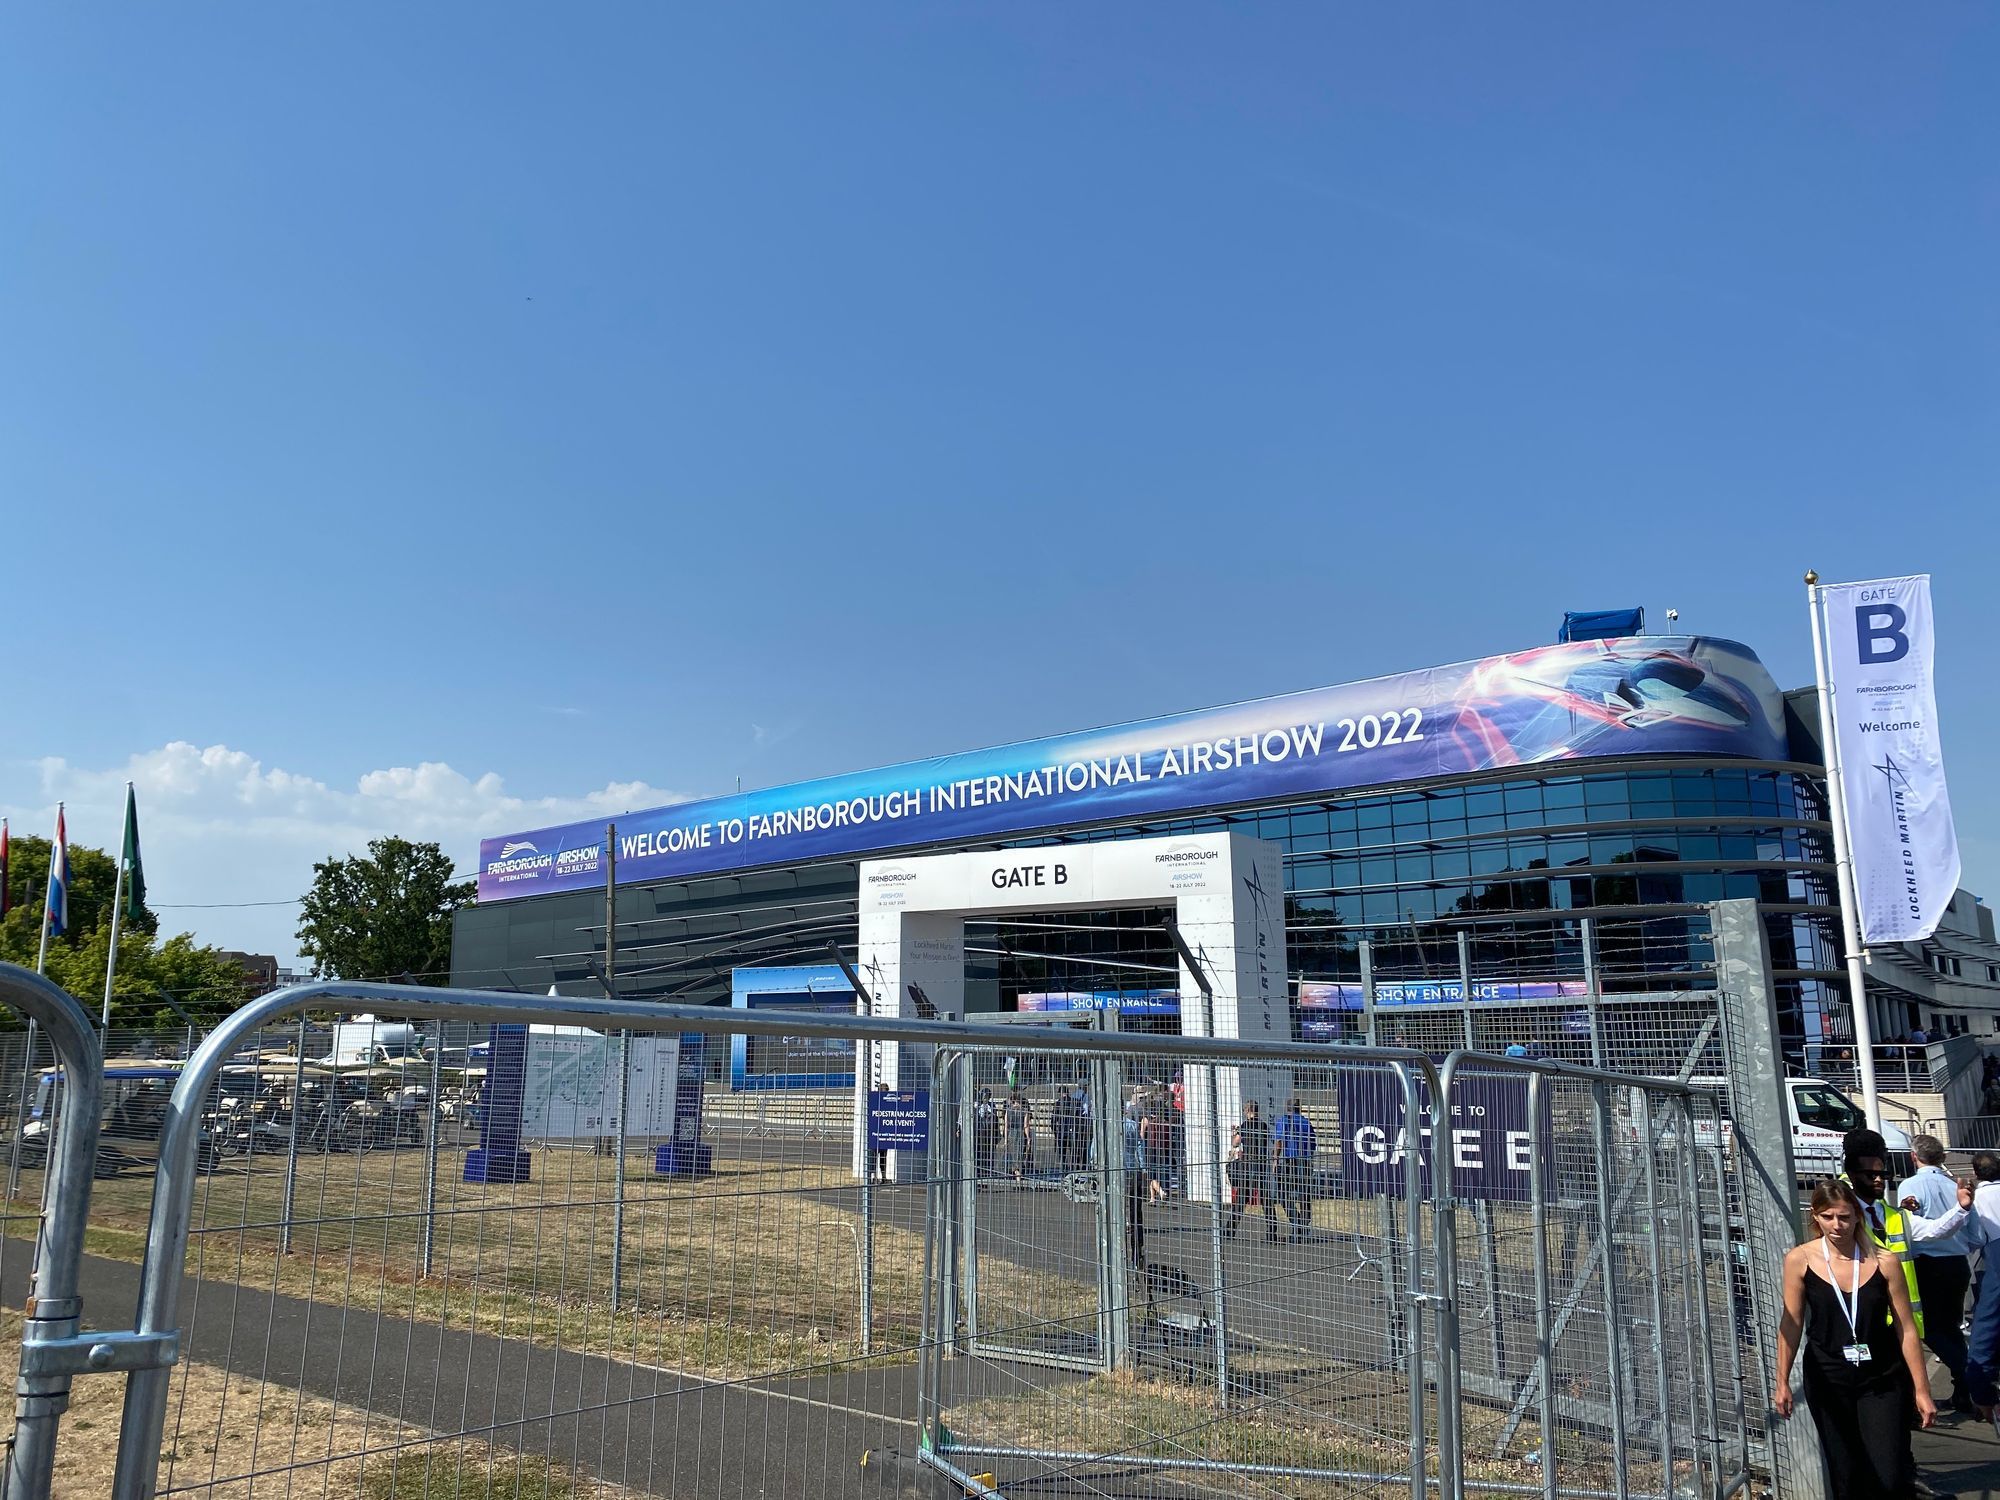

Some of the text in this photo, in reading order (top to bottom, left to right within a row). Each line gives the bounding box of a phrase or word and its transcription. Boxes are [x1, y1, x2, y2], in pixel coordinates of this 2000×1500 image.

[1861, 588, 1897, 601] GATE
[1855, 603, 1909, 665] B
[1856, 684, 1917, 694] FARNBOROUGH
[1859, 720, 1921, 733] Welcome
[621, 706, 1424, 859] WELCOME TO FARNBOROUGH INTERNATIONAL AIRSHOW 2022
[557, 846, 599, 865] AIRSHOW
[1155, 850, 1218, 862] FARNBOROUGH
[1895, 791, 1921, 920] LOCKHEED MARTIN
[488, 853, 552, 875] FARNBOROUGH
[557, 862, 598, 874] 18-22 JULY 2022
[498, 871, 539, 882] INTERNATIONAL
[868, 873, 917, 883] FARNBOROUGH
[991, 864, 1068, 888] GATE B
[1376, 990, 1417, 1001] SHOW
[1073, 996, 1163, 1009] SHOW ENTRANCE
[872, 1110, 904, 1118] PEDESTRIAN
[1468, 1105, 1485, 1116] TO
